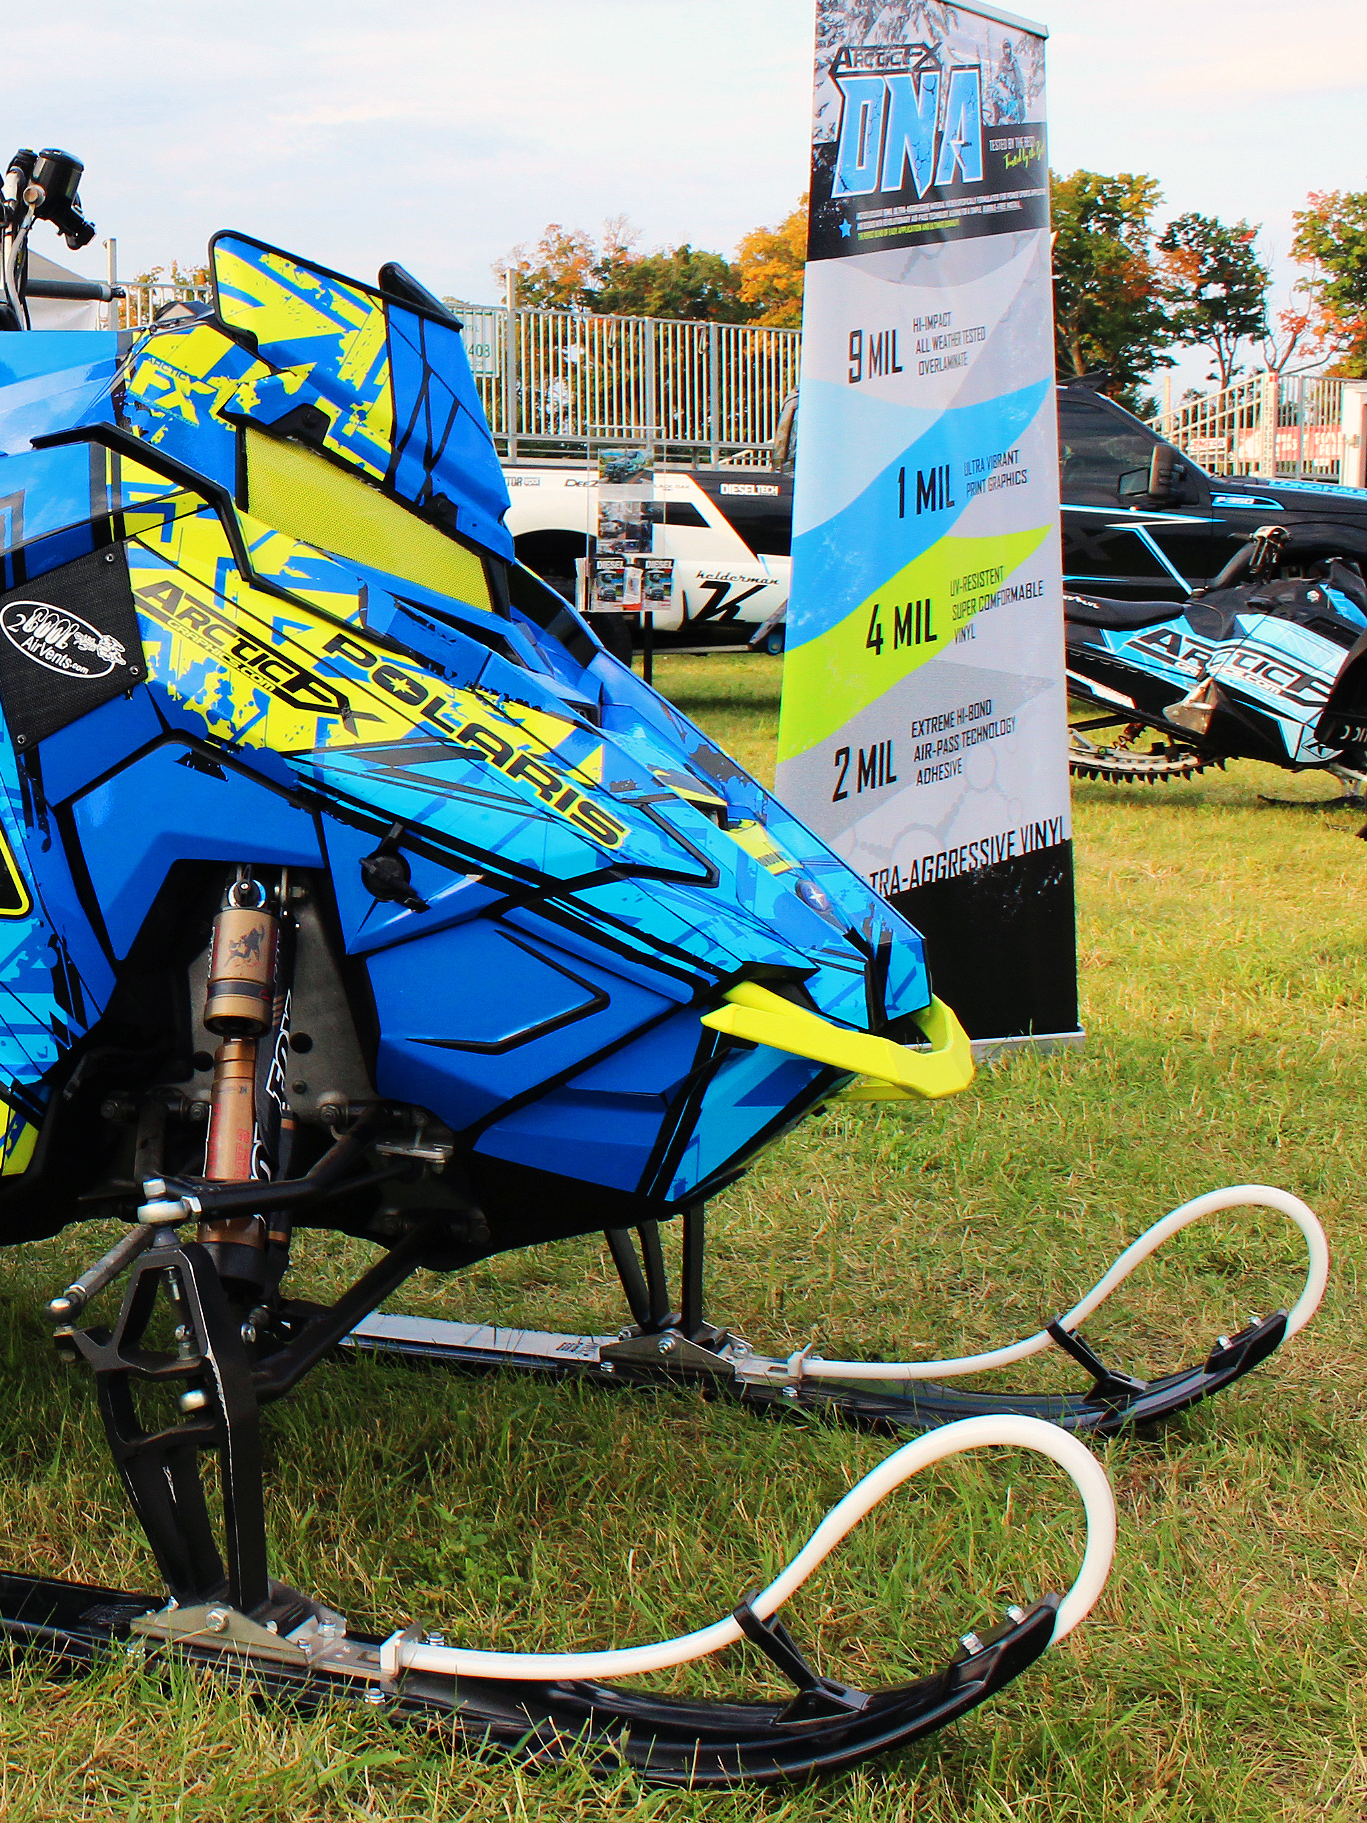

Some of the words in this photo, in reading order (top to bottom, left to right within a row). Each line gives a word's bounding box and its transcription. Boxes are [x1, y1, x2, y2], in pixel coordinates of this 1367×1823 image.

[830, 66, 984, 199] DNA
[912, 312, 952, 333] HI-IMPACT
[915, 338, 930, 354] ALL
[931, 331, 962, 351] WEATHER
[962, 326, 986, 345] TESTED
[849, 329, 863, 384] 9
[868, 329, 903, 379] MIL
[918, 351, 968, 376] OVERLAMINATE
[129, 360, 218, 425] FX
[963, 458, 985, 476] ULTRA
[987, 450, 1019, 470] VIBRANT
[966, 479, 986, 497] PRINT
[987, 469, 1028, 492] GRAPHICS
[898, 466, 905, 518] 1
[916, 464, 955, 515] MIL
[949, 565, 1004, 597] UV-RESISTENT
[952, 598, 977, 621] SUPER
[978, 580, 1044, 612] COMFORMABLE
[866, 603, 883, 655] 4
[894, 599, 937, 650] MIL
[954, 623, 976, 645] VINYL
[911, 711, 955, 738] EXTREME
[956, 699, 992, 726] HI-BOND
[913, 734, 960, 762] AIR-PASS
[961, 715, 1016, 749] TECHNOLOGY
[322, 632, 627, 847] POLARIS
[832, 746, 851, 803] 2
[856, 739, 897, 794] MIL
[915, 757, 962, 786] ADHESIVE
[1020, 815, 1066, 857] VINYL
